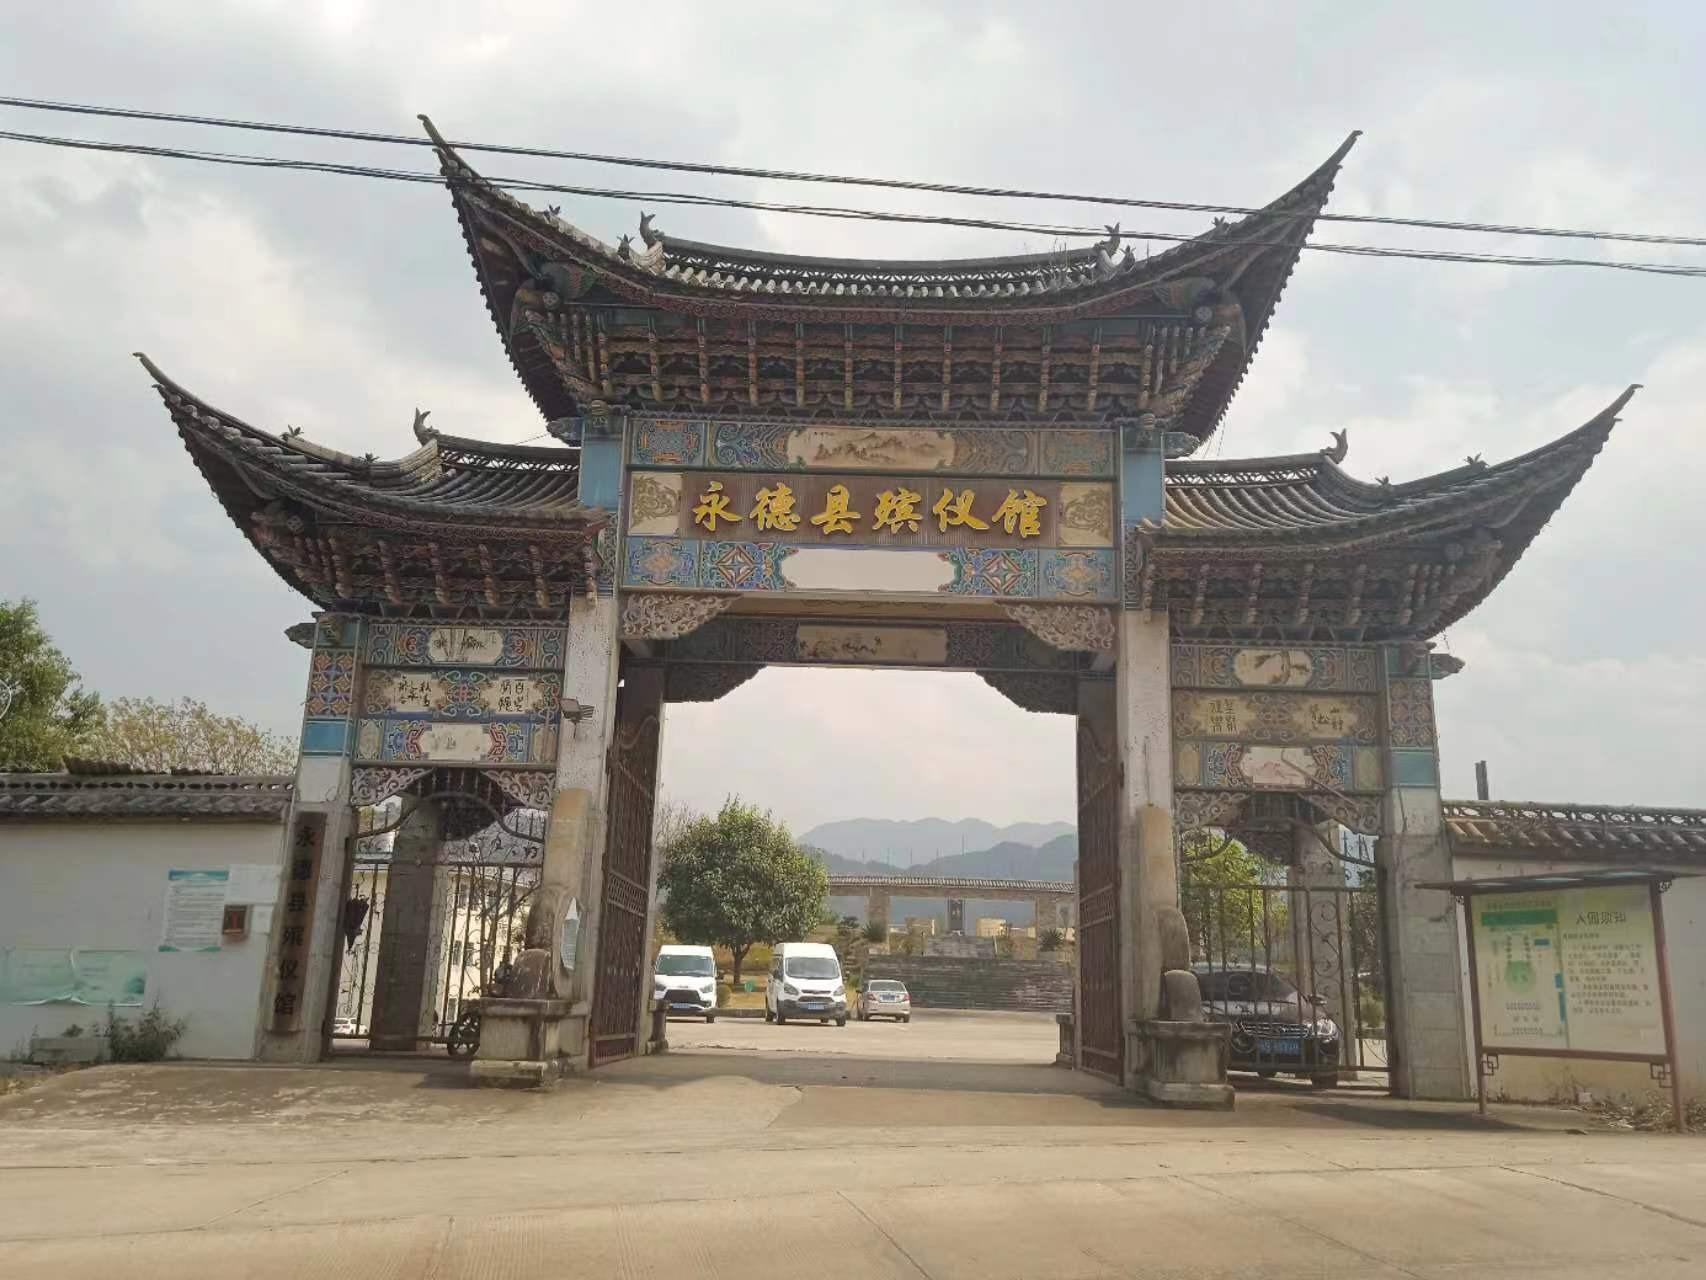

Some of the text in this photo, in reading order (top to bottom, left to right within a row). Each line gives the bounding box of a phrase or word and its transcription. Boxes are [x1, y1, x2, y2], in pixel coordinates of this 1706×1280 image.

[692, 480, 1048, 538] 永德县殡仪馆
